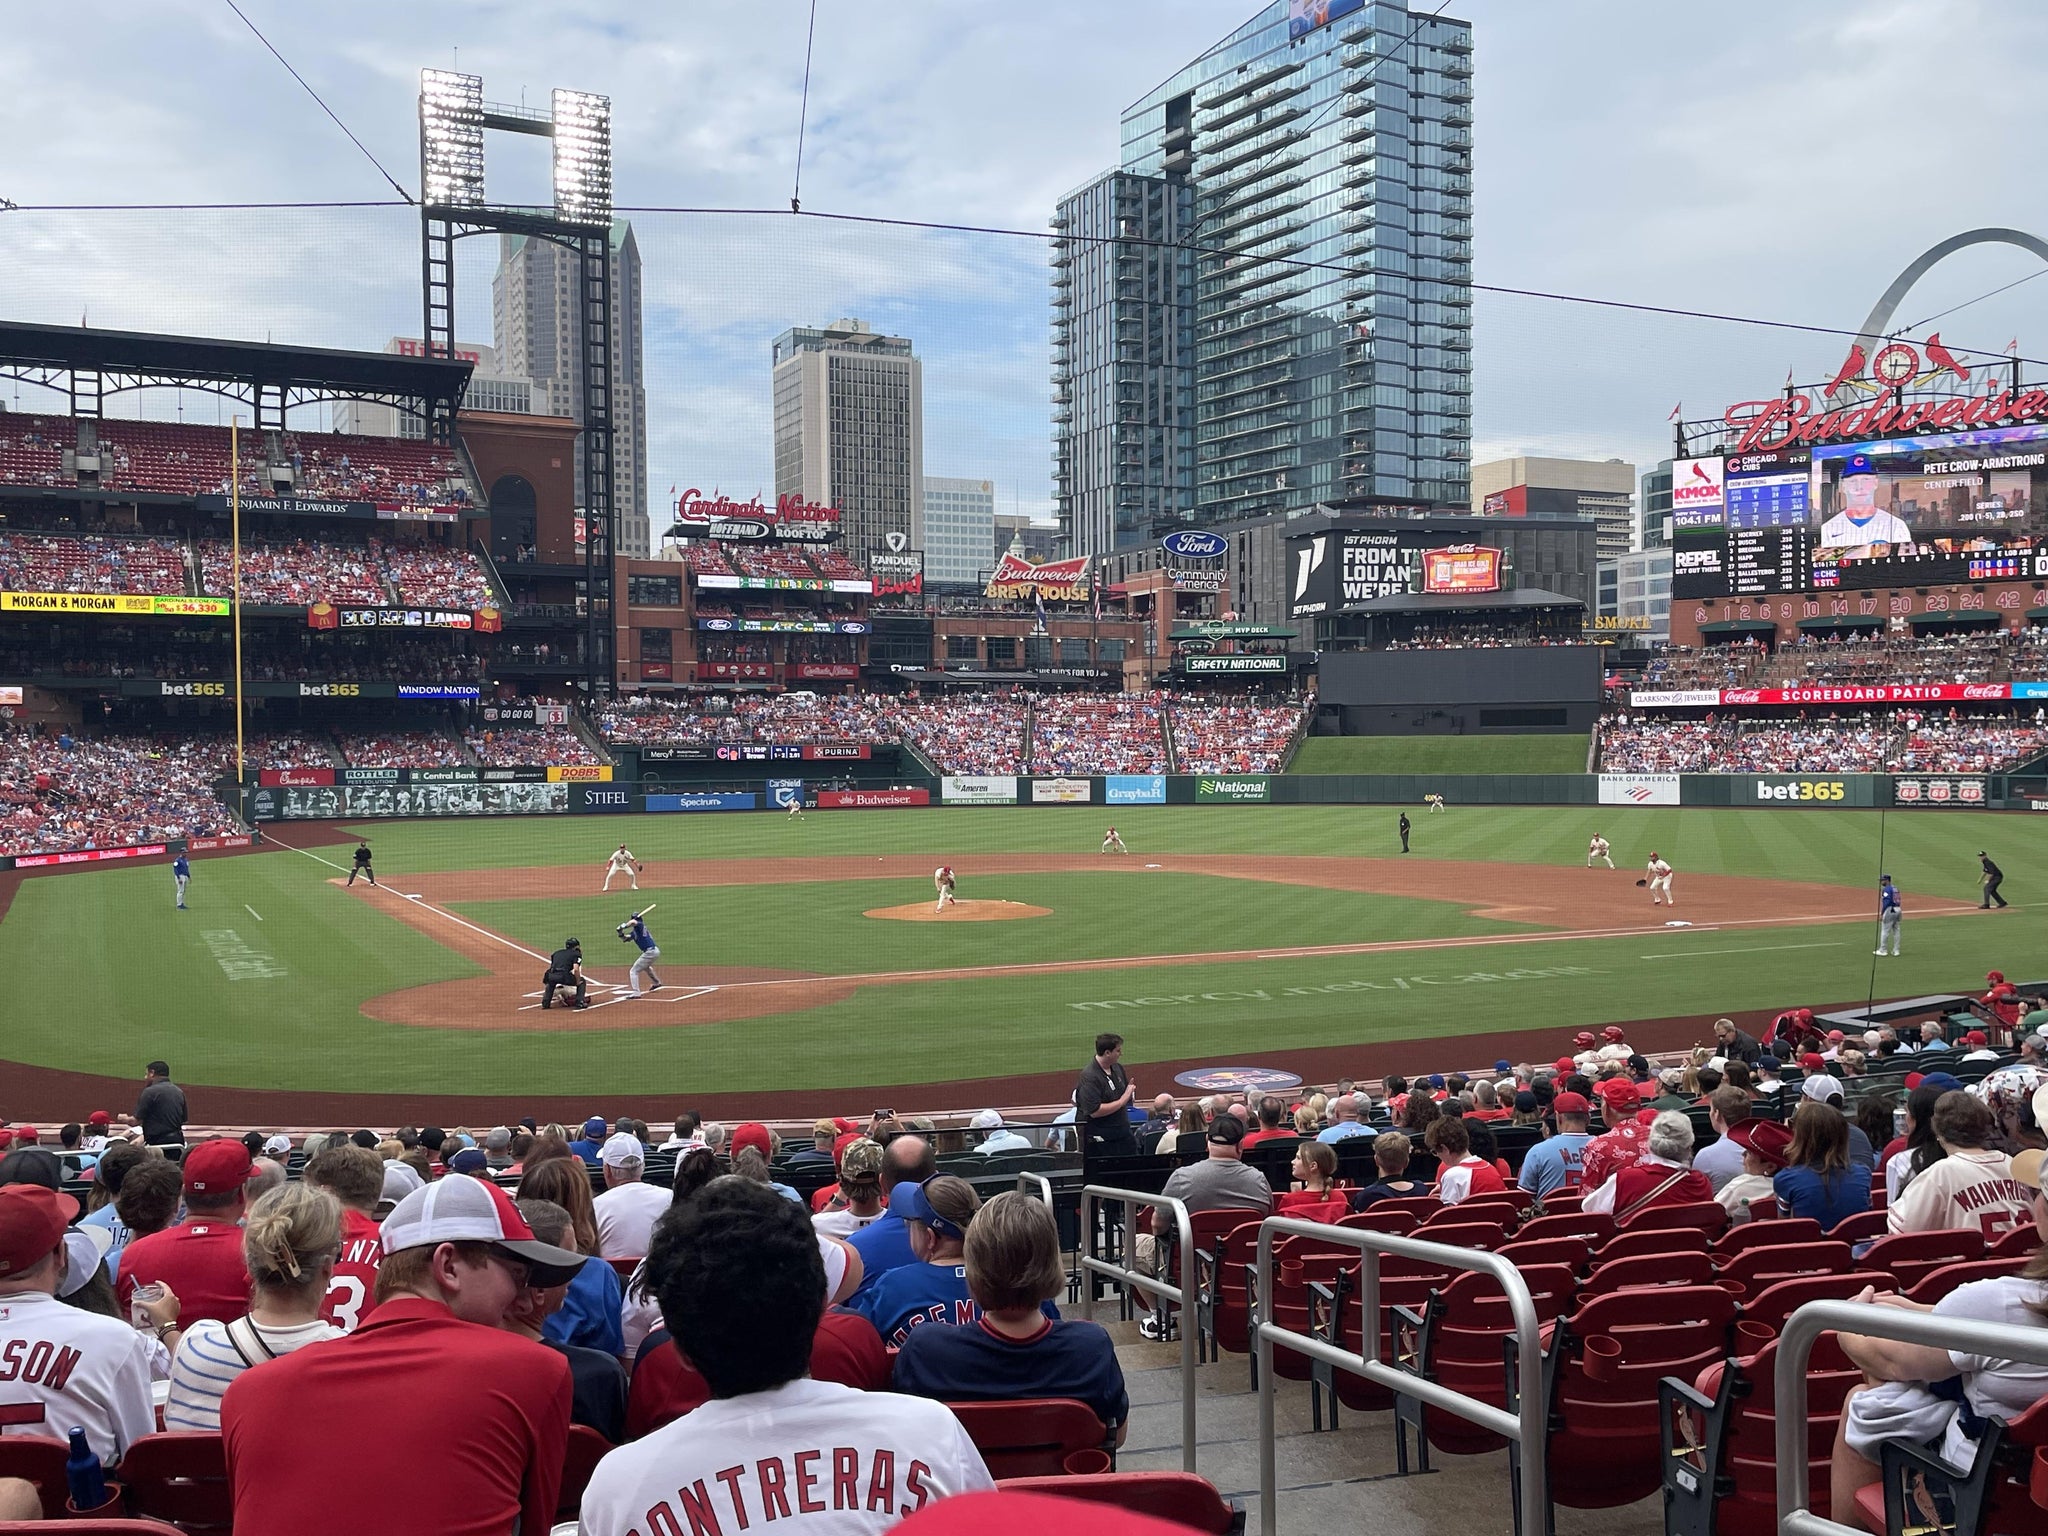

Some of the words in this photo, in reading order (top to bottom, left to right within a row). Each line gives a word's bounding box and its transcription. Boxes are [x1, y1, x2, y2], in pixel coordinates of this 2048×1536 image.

[1725, 378, 2048, 452] Budweise
[1742, 454, 1777, 464] CHICAGO
[1924, 462, 1948, 474] PETE
[1950, 454, 2045, 473] CROW-ARMSTRONG
[1742, 463, 1760, 471] CUBS
[1924, 480, 1957, 490] CENTER
[1959, 477, 1983, 486] FIELD
[1674, 486, 1721, 500] KMOX
[226, 497, 283, 510] BNJAMIN
[294, 501, 345, 513] EDWARDS
[679, 488, 766, 522] Cardinals
[768, 494, 840, 523] Nation
[1675, 516, 1701, 526] 104.1
[1705, 514, 1721, 523] FM
[710, 523, 758, 535] HOFFMANN
[776, 528, 826, 539] ROOFTOP
[1177, 533, 1216, 552] Ford
[1359, 536, 1398, 545] PHORM
[872, 556, 921, 566] FANDUEL
[1343, 548, 1396, 565] FROM
[1675, 550, 1721, 567] REPEL
[994, 562, 1088, 582] Budweiser
[1343, 565, 1378, 581] LOU
[1821, 570, 1837, 578] CHC
[2040, 560, 2046, 572] 0
[1168, 568, 1227, 583] Community
[987, 584, 1030, 599] BREW
[12, 596, 57, 608] MORGAN
[61, 597, 68, 608] &
[72, 597, 116, 609] MORGAN
[1724, 606, 1730, 620] 1
[1739, 606, 1750, 619] 2
[1760, 605, 1771, 619] 6
[1781, 603, 1792, 618] 9
[1803, 602, 1820, 617] 10
[1831, 600, 1849, 616] 14
[1860, 598, 1878, 615] 17
[1889, 597, 1911, 613] 20
[1926, 595, 1949, 611] 23
[1960, 594, 1983, 610] 24
[1996, 592, 2020, 608] 42
[341, 611, 376, 627] BIG
[379, 611, 422, 627] MAC
[424, 611, 472, 629] LAND
[1594, 616, 1652, 629] SMOKE
[1192, 659, 1227, 669] SAFETY
[1230, 659, 1280, 669] NATIONAL
[162, 682, 225, 696] bet365
[300, 683, 360, 696] bet365
[398, 685, 440, 694] WINDOW
[444, 686, 480, 695] NATION
[1782, 689, 1885, 701] SCOREBOARD
[1893, 687, 1941, 699] PATIO
[1635, 695, 1670, 703] CLARKSON
[1684, 694, 1717, 702] JEWELERS
[501, 710, 511, 719] GO
[512, 710, 522, 719] GO
[523, 710, 533, 719] GO
[549, 711, 563, 722] 63
[651, 751, 669, 759] Mercy
[825, 748, 858, 756] PURINA
[348, 770, 397, 778] ROTTLER
[423, 771, 452, 780] Central
[455, 771, 477, 780] Bank
[562, 768, 600, 776] DOBBS
[769, 779, 800, 788] CarShield
[961, 783, 987, 793] Ameren
[1214, 781, 1265, 793] National
[1757, 781, 1845, 800] bet365
[1902, 789, 1917, 797] 66
[1932, 789, 1947, 797] 66
[1963, 789, 1978, 797] 66
[585, 790, 629, 805] STIFEL
[681, 798, 718, 807] Spectrum
[857, 795, 910, 805] Budweiser
[625, 1447, 932, 1536] ONTRERAS
